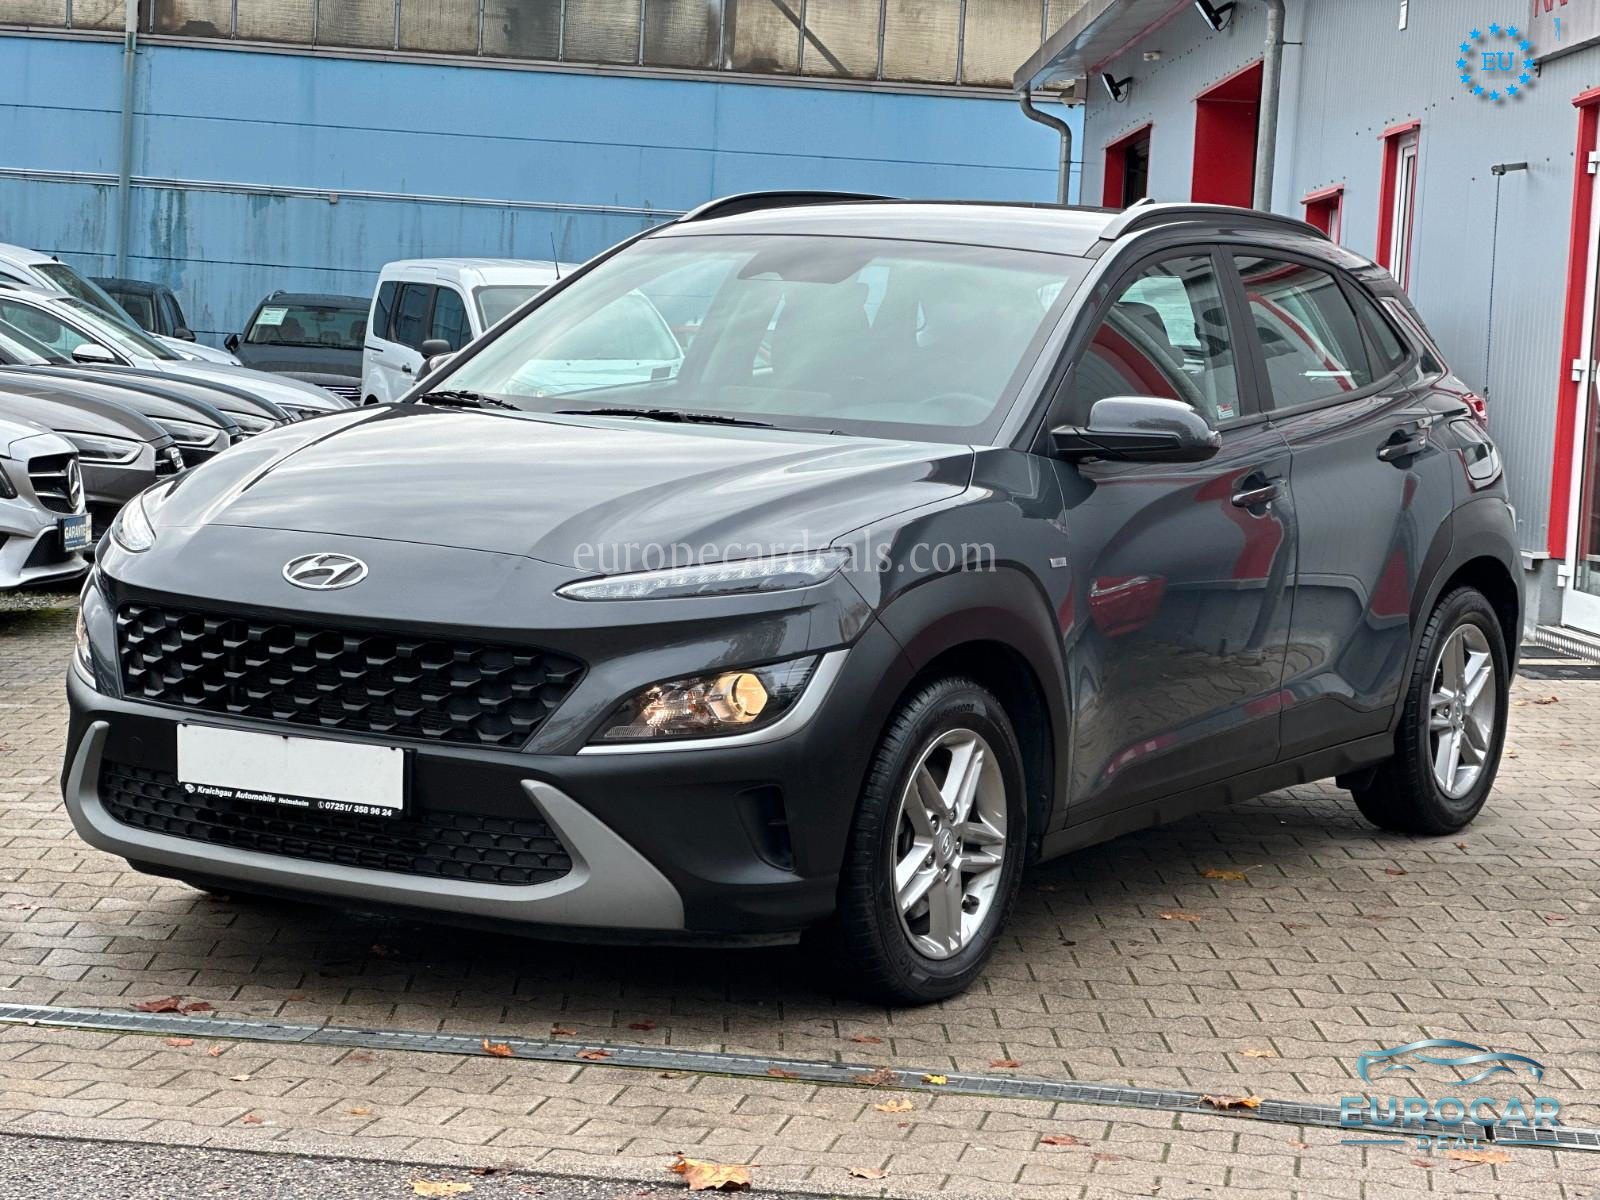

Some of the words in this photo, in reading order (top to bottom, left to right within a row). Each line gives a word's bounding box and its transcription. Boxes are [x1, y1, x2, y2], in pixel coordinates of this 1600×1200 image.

[197, 785, 233, 798] Kraichgau
[235, 790, 276, 803] Automobile
[325, 801, 353, 812] 07251/
[353, 805, 369, 814] 358
[370, 807, 380, 815] 96
[381, 808, 393, 817] 24
